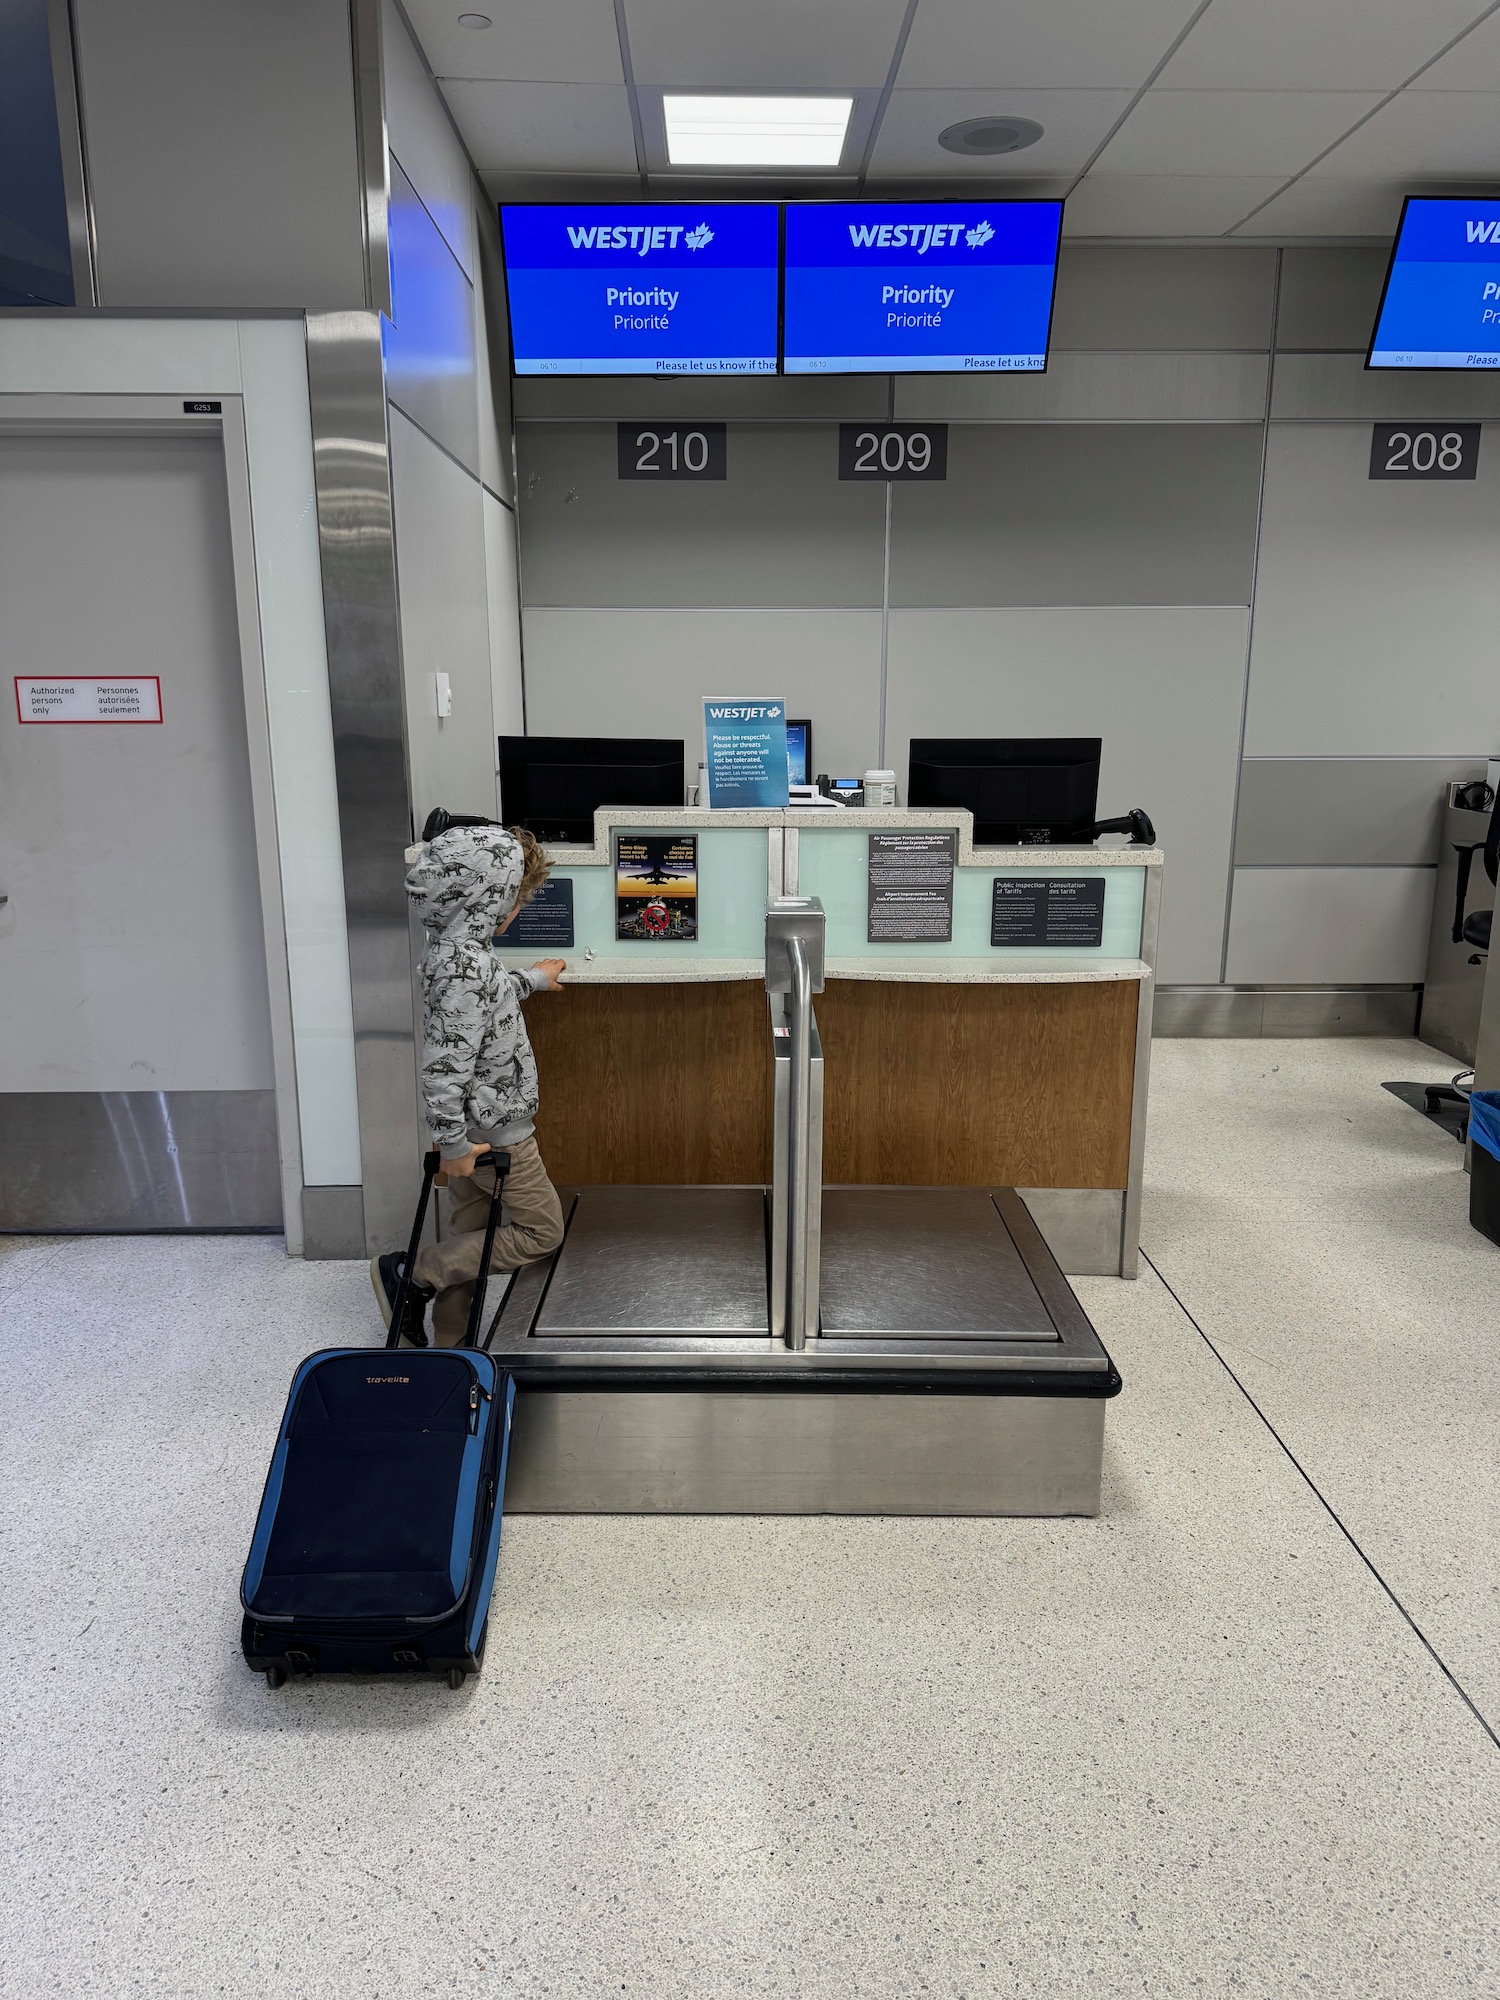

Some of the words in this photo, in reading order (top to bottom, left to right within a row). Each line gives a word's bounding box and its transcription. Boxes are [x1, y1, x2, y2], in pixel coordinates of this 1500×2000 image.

[567, 226, 684, 257] WESTJET
[848, 224, 966, 255] WESTJET
[606, 287, 680, 311] Priority
[882, 285, 955, 309] Priority
[614, 313, 669, 330] Priorité
[887, 311, 942, 327] Priorité
[656, 361, 688, 370] Please
[690, 360, 704, 370] let
[706, 362, 717, 370] us
[719, 360, 747, 370] know
[749, 360, 756, 369] if
[757, 359, 778, 369] the
[964, 357, 996, 367] Please
[998, 357, 1012, 367] let
[1014, 359, 1025, 367] us
[1395, 355, 1413, 363] 06:10
[1466, 354, 1498, 365] Please
[540, 362, 558, 370] 06:10
[635, 431, 709, 472] 210
[854, 432, 932, 472] 209
[1384, 432, 1463, 472] 208
[30, 687, 75, 695] Authorized
[97, 686, 139, 694] Personnes
[31, 697, 63, 705] persons
[98, 695, 140, 704] autorisées
[32, 707, 50, 715] only
[99, 706, 140, 714] seulement
[709, 707, 767, 721] WESTJET
[366, 1376, 410, 1384] travelite
